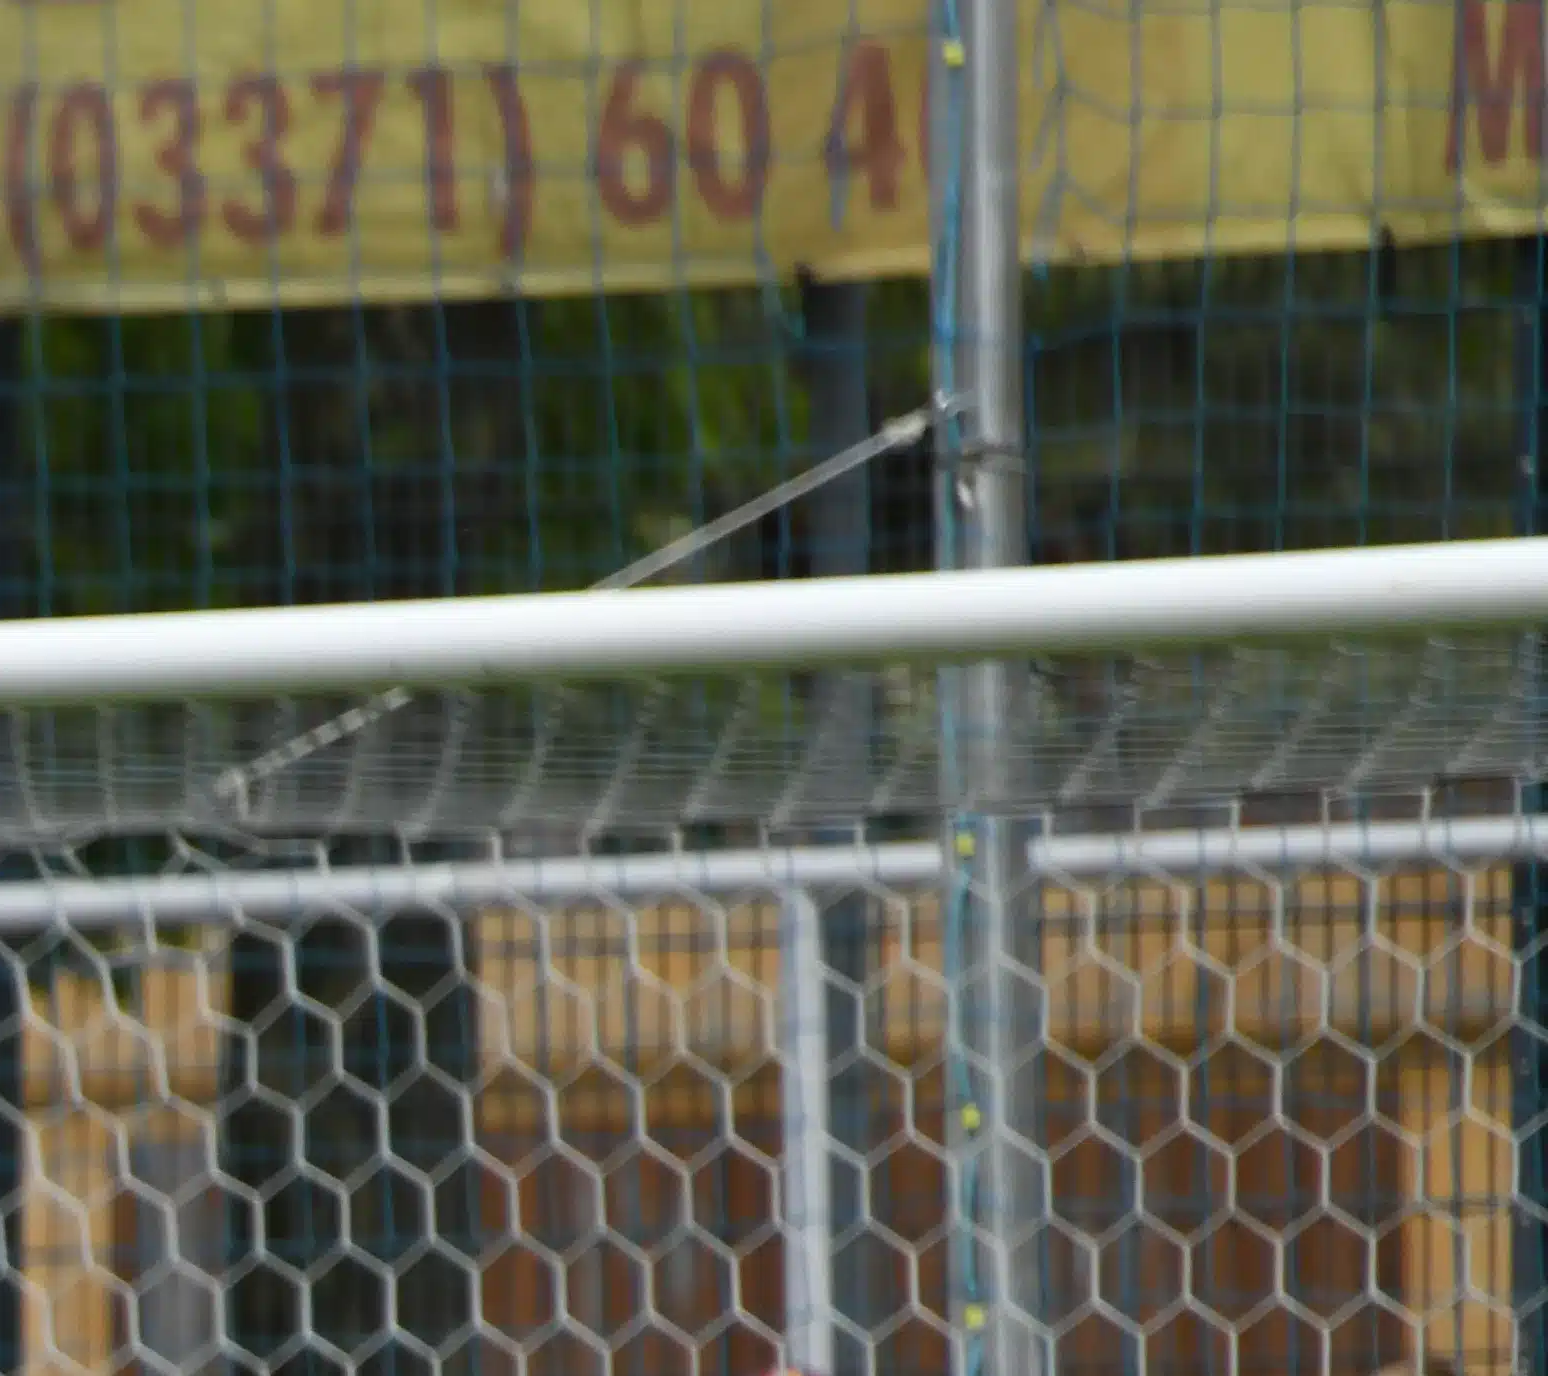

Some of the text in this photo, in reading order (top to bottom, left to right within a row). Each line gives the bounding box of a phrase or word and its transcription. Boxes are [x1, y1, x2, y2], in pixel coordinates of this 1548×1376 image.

[3, 38, 944, 272] (03371) 60 4
